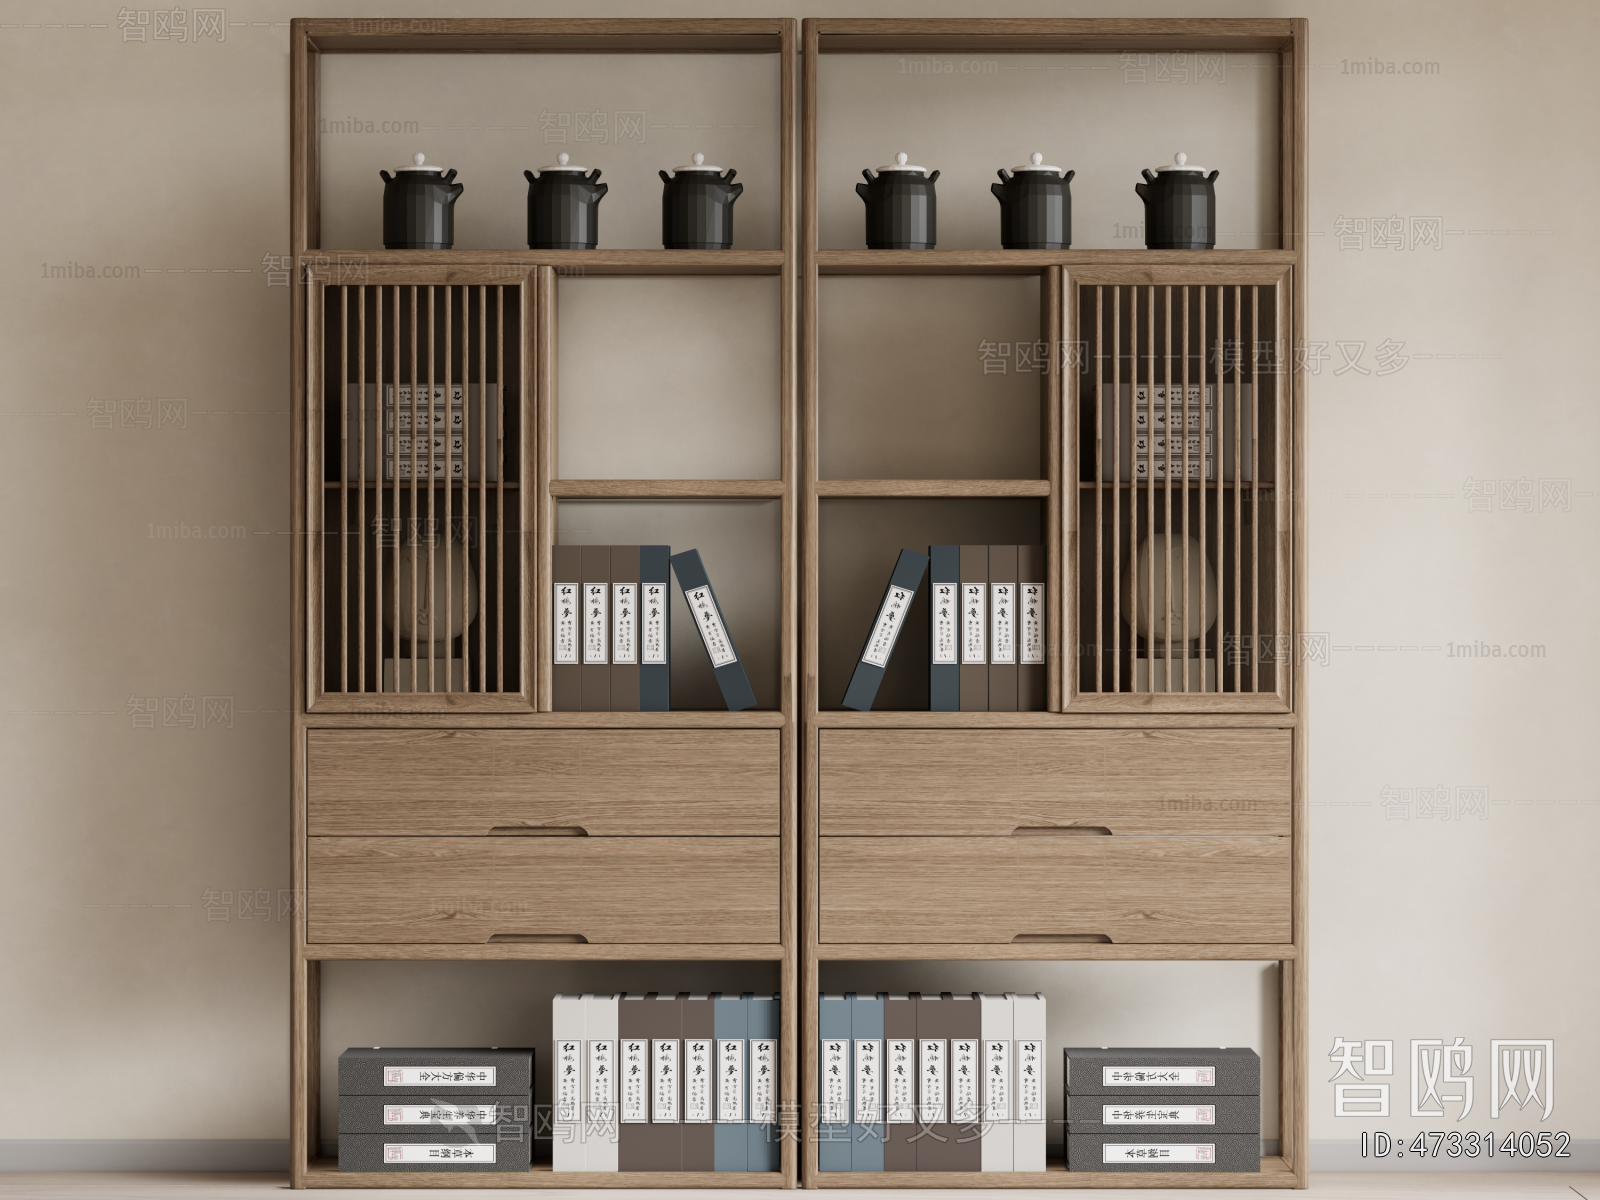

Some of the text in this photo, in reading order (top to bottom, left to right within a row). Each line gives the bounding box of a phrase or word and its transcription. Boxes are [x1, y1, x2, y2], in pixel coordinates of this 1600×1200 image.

[419, 1071, 487, 1082] 中华偏方大全
[419, 1109, 487, 1120] 中华养生宝典
[429, 1148, 474, 1159] 本草纲目
